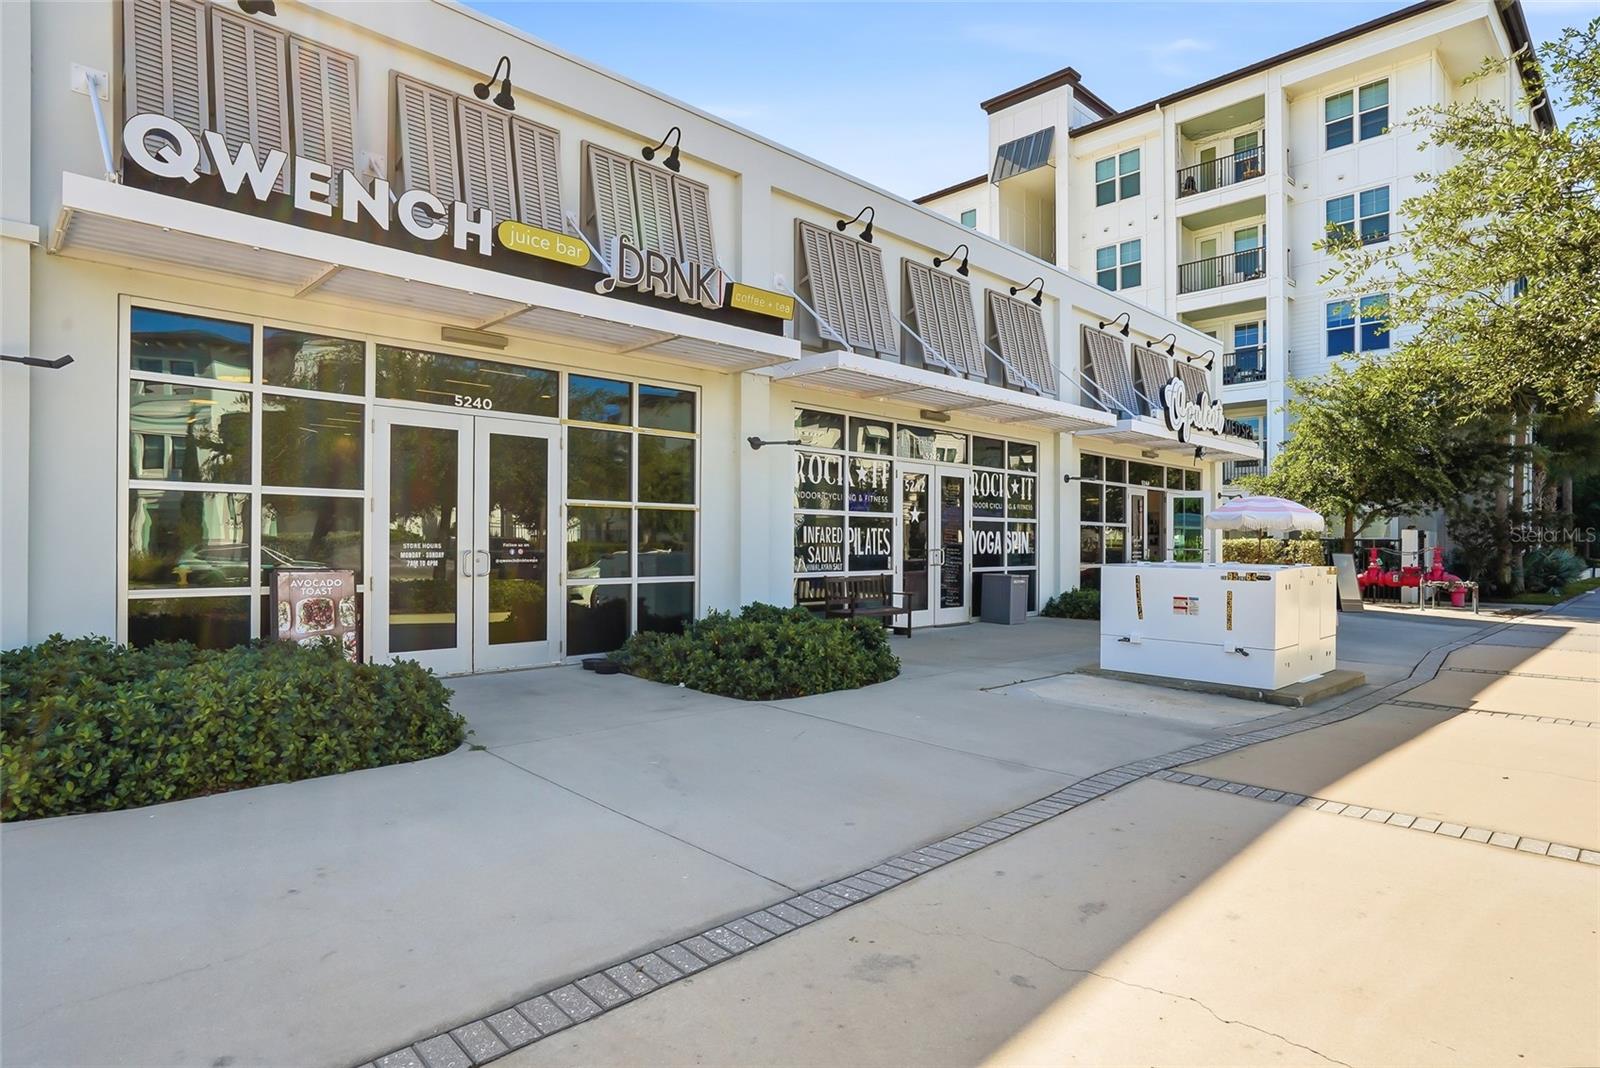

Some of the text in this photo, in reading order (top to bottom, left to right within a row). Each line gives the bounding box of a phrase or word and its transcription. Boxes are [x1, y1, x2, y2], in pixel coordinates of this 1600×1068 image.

[123, 113, 493, 256] QWENCH
[509, 225, 582, 259] juice bar
[735, 293, 765, 307] coffee
[775, 303, 790, 313] tea
[454, 395, 493, 410] 5240
[1224, 419, 1241, 436] MED
[872, 461, 890, 489] IT
[864, 494, 889, 503] FITNESS
[1021, 477, 1034, 501] IT
[803, 525, 843, 544] INFARED
[848, 527, 890, 555] PILATES
[972, 530, 1030, 554] YOGA SPIN
[808, 546, 841, 563] SAUNA
[290, 579, 342, 588] AVOCADO
[301, 587, 333, 595] TOAST
